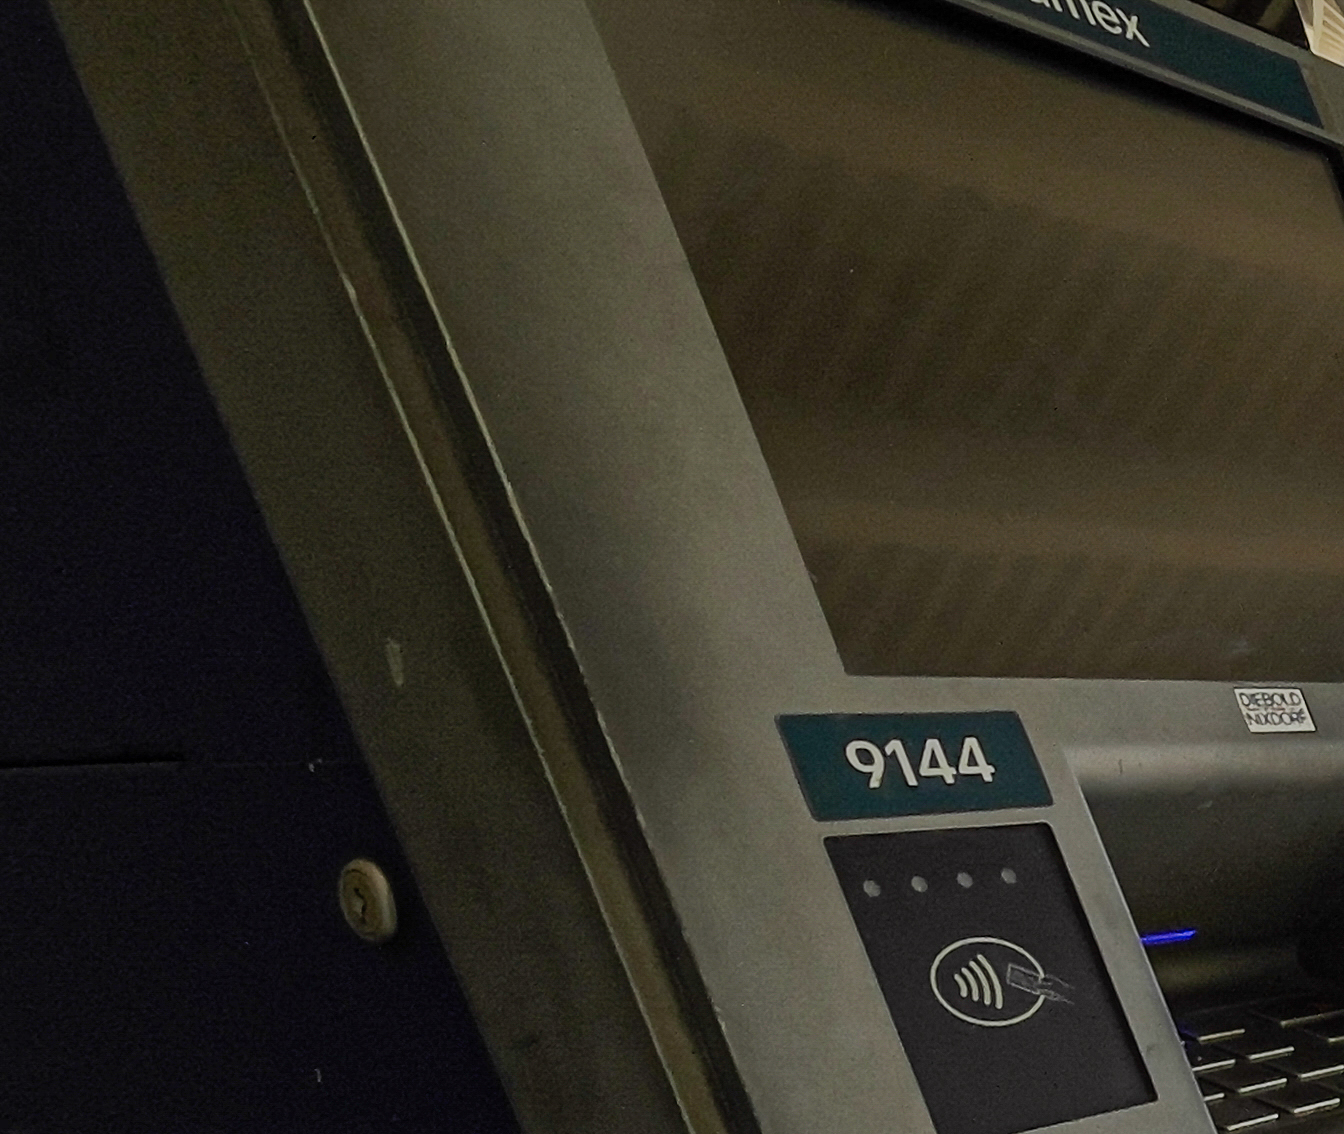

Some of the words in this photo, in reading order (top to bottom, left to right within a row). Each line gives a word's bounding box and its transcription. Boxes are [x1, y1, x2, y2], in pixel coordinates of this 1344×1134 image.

[1239, 692, 1301, 706] DIEBOLD
[1245, 708, 1306, 725] NIXDORF
[845, 737, 996, 788] 9144
